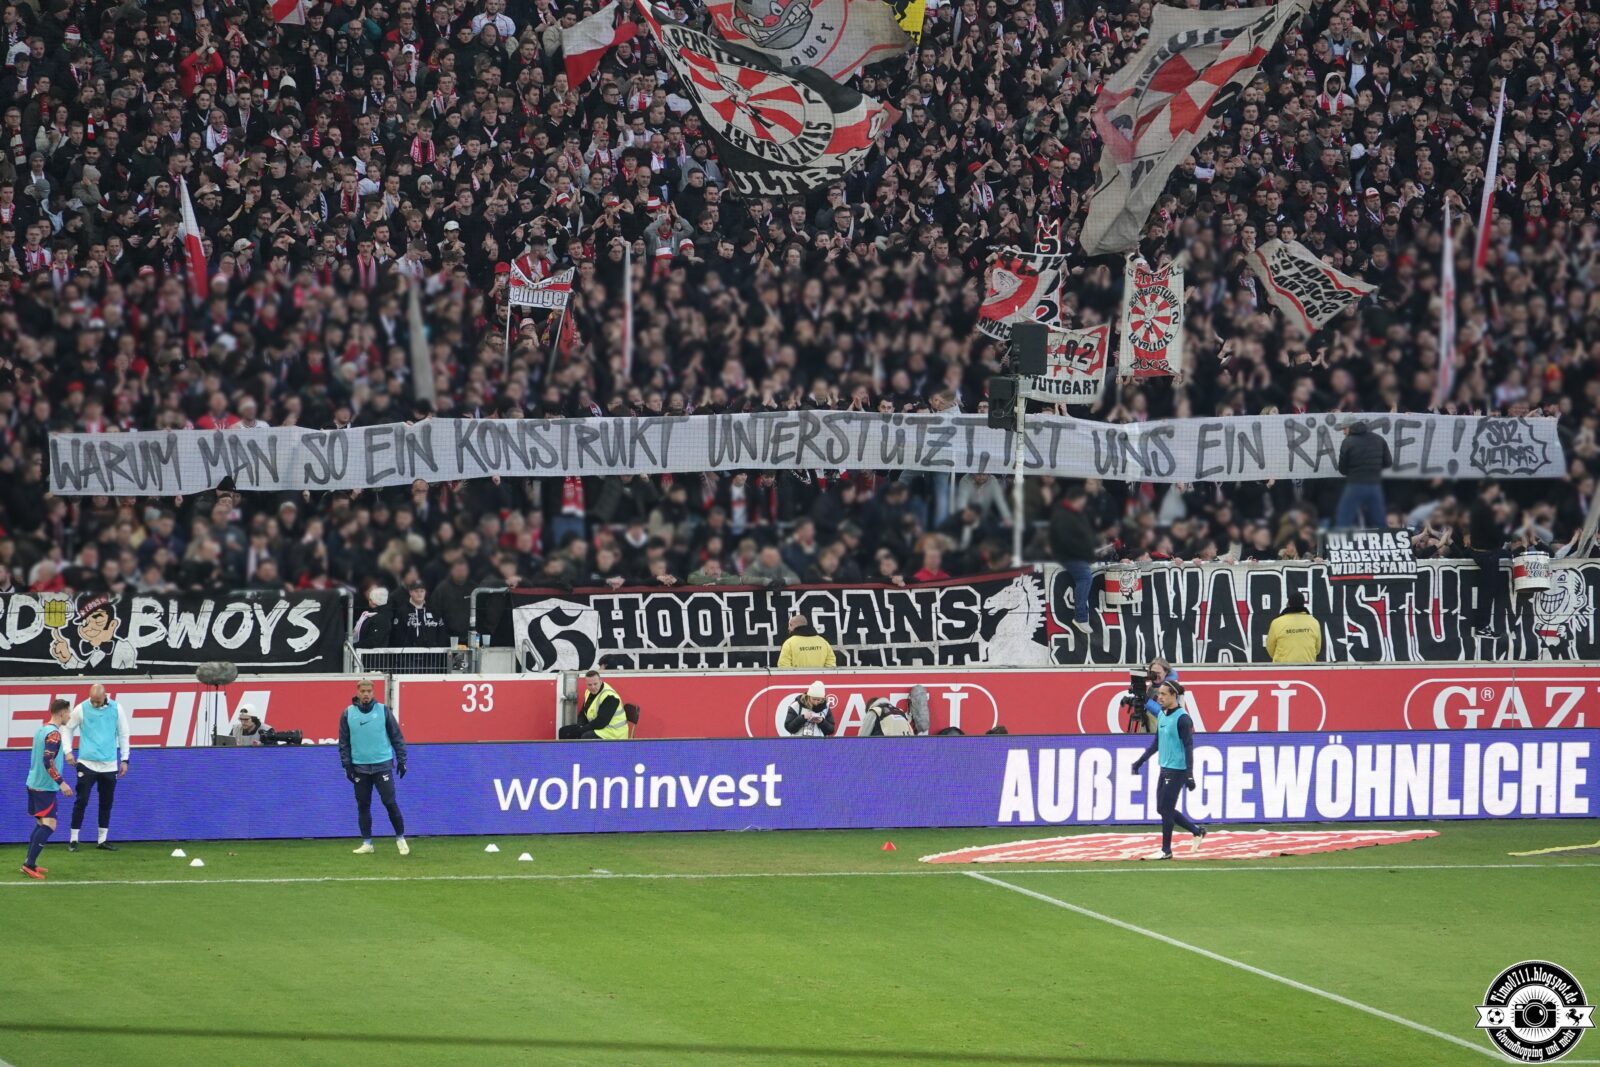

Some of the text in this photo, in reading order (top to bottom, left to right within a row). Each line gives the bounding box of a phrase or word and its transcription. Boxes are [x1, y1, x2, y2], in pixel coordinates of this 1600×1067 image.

[1024, 374, 1100, 395] TUTTGART
[50, 434, 182, 492] WARUM
[198, 432, 280, 487] MAN
[302, 431, 349, 485] SO
[363, 421, 438, 485] EIN
[453, 415, 690, 474] KONSTRUKT
[1091, 425, 1177, 477] UNS
[1197, 419, 1267, 479] EIN
[1284, 413, 1460, 476] RÄEL!
[1327, 531, 1411, 551] ULTRAS
[1329, 549, 1413, 563] BEDEUTET
[1330, 561, 1417, 575] WIDERSTAND
[130, 597, 322, 655] BWOYS
[589, 585, 981, 650] HOOLIGANS
[461, 683, 495, 713] 33
[493, 763, 783, 811] wohninvest
